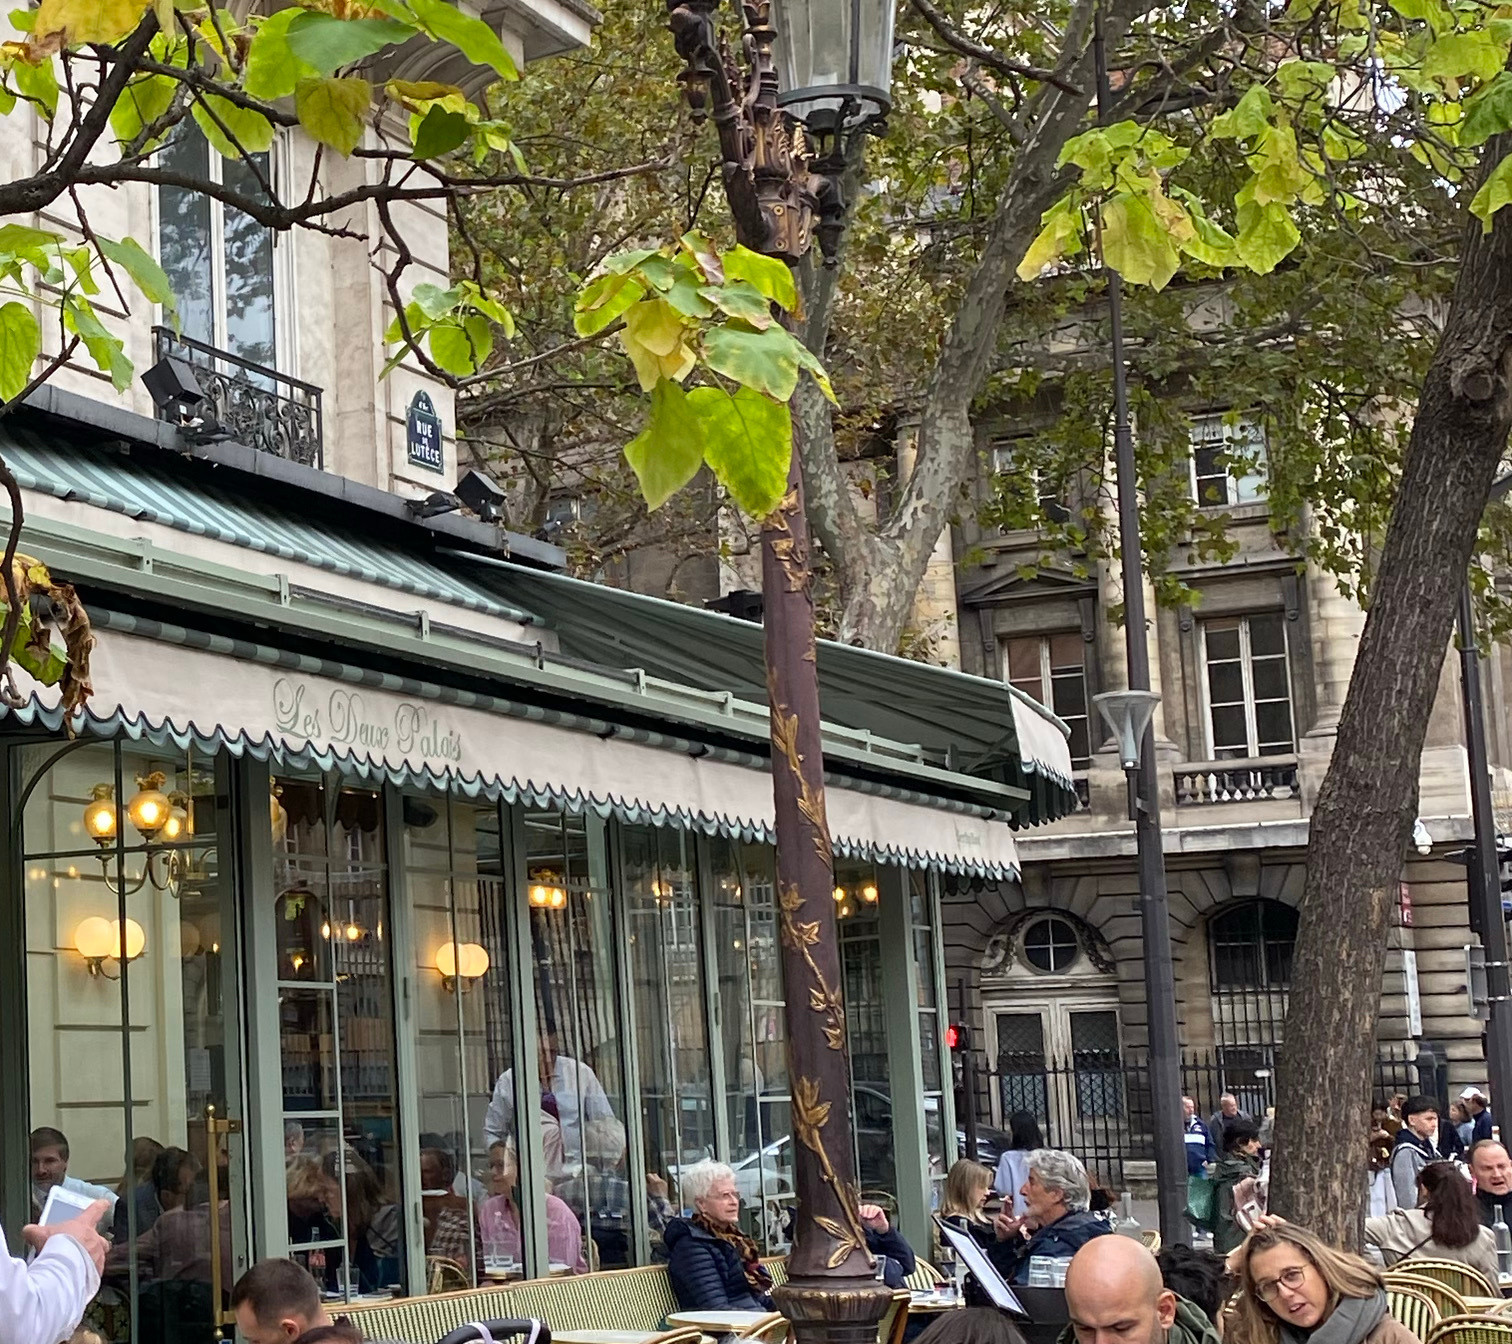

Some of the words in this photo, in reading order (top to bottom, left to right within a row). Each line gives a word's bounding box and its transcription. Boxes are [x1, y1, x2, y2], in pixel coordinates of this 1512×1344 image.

[416, 420, 433, 438] RUE
[272, 677, 321, 739] Les
[328, 689, 390, 751] Deux
[394, 703, 463, 762] Palais
